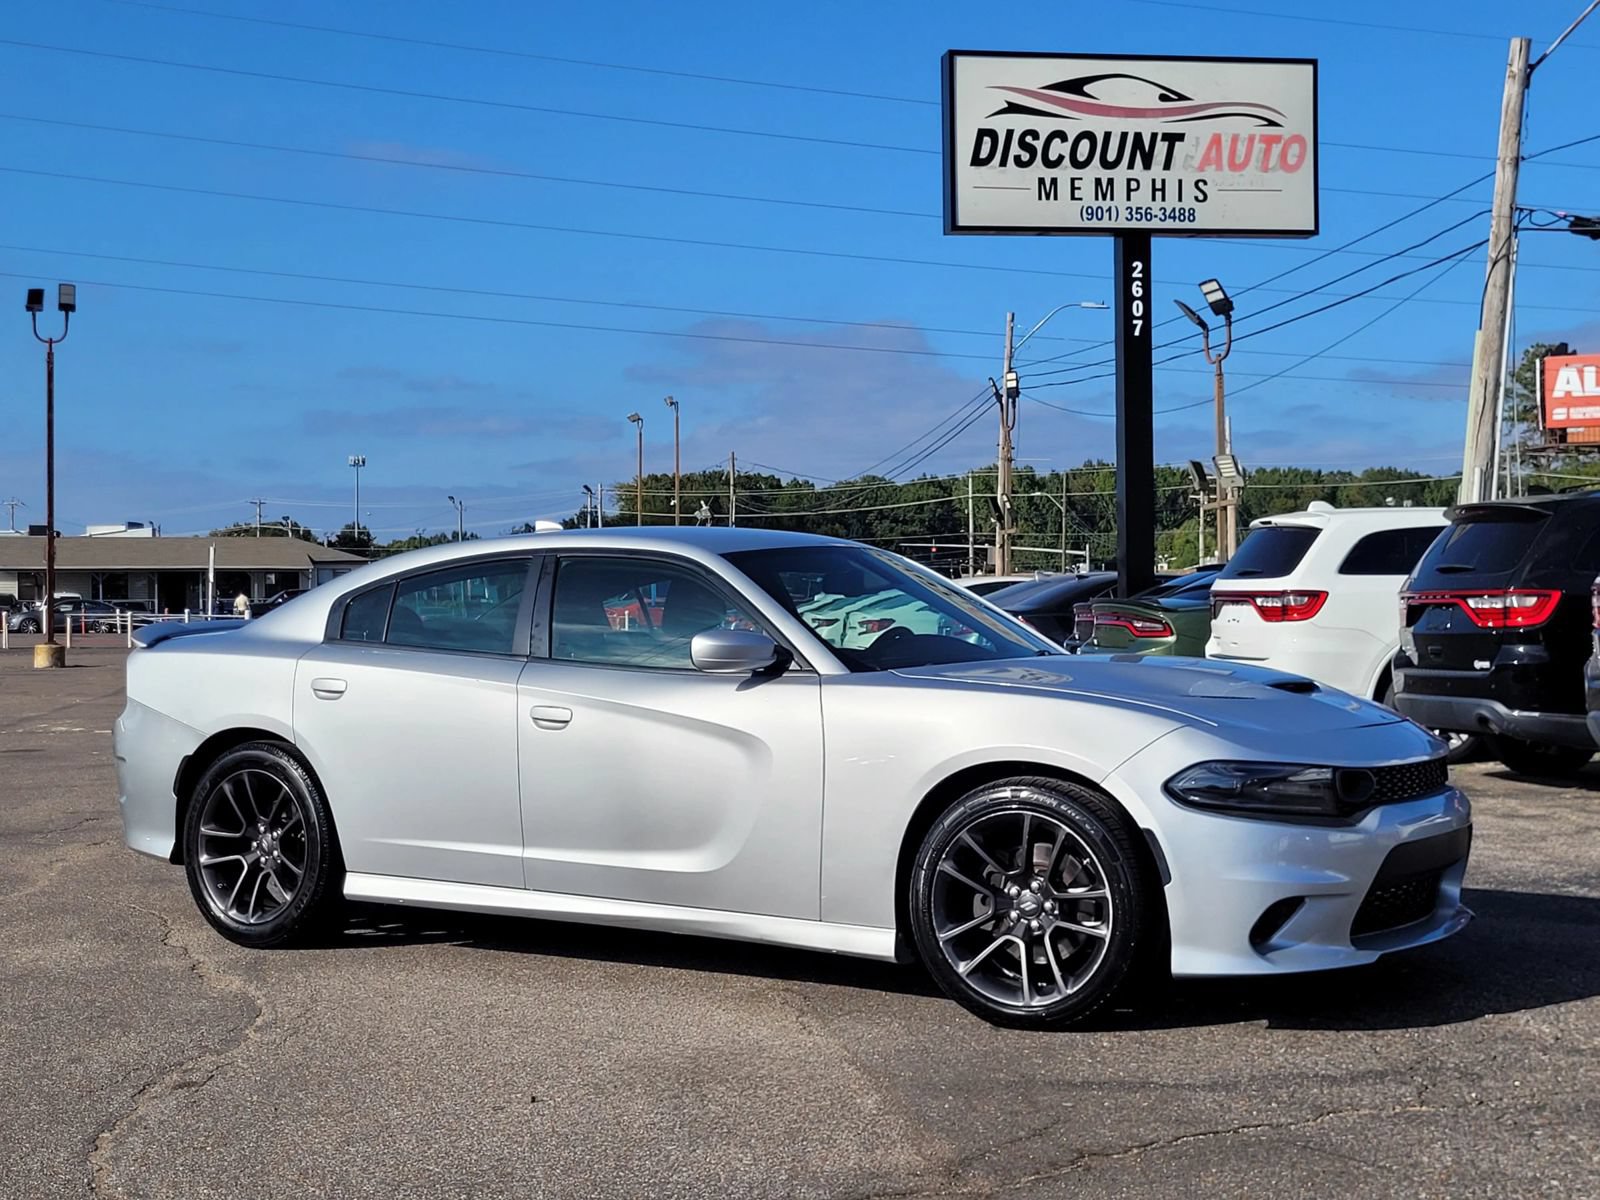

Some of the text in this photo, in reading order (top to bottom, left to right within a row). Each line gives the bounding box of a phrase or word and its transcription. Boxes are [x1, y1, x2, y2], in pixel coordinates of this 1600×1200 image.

[970, 127, 1308, 174] DISCOUNT AUTO
[1037, 176, 1209, 204] MEMPHIS
[1079, 204, 1197, 224] (901) 356-3488
[1131, 260, 1144, 338] 2607
